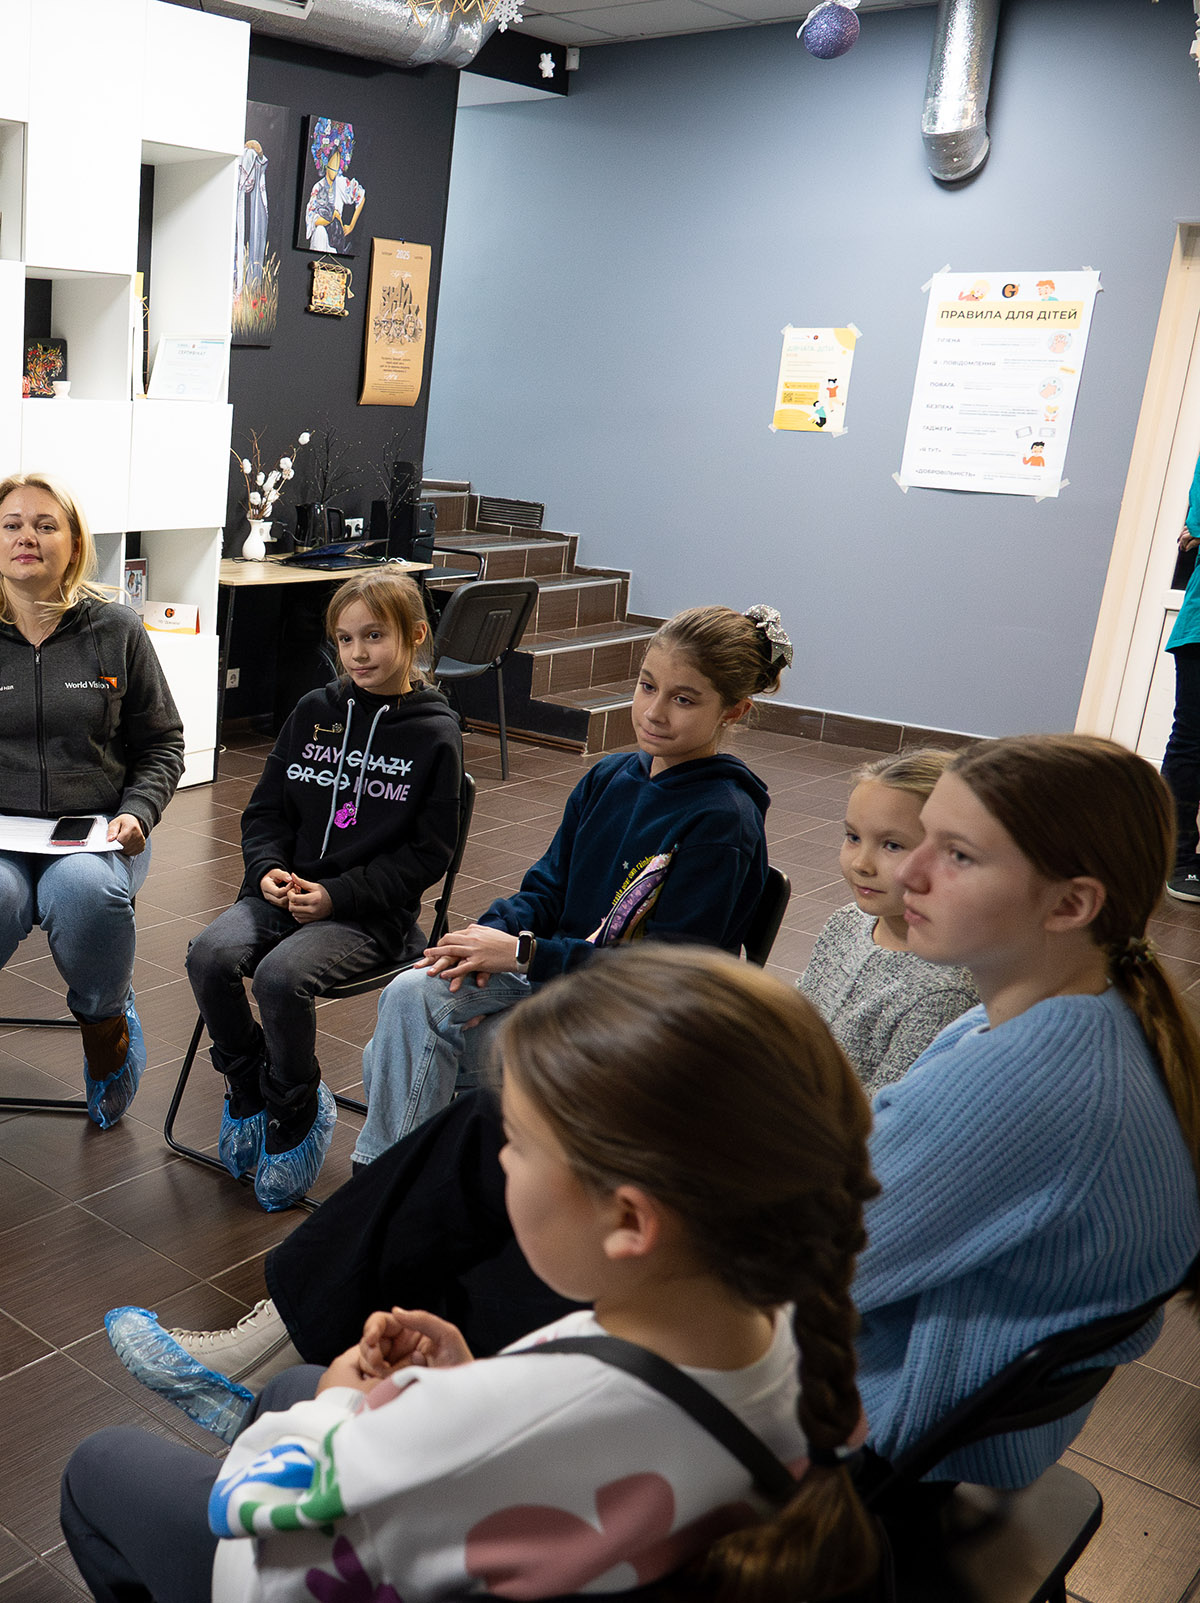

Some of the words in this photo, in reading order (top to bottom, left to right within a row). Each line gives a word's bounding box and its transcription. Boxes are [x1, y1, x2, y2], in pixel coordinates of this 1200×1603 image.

[940, 310, 1002, 320] ПРАВИЛА
[1005, 310, 1033, 321] ДЛЯ
[1036, 308, 1078, 321] ДІТЕЙ
[64, 681, 88, 689] World
[88, 680, 110, 689] Vision
[301, 743, 344, 764] STAY
[286, 763, 315, 782] OR
[352, 776, 411, 801] HOME
